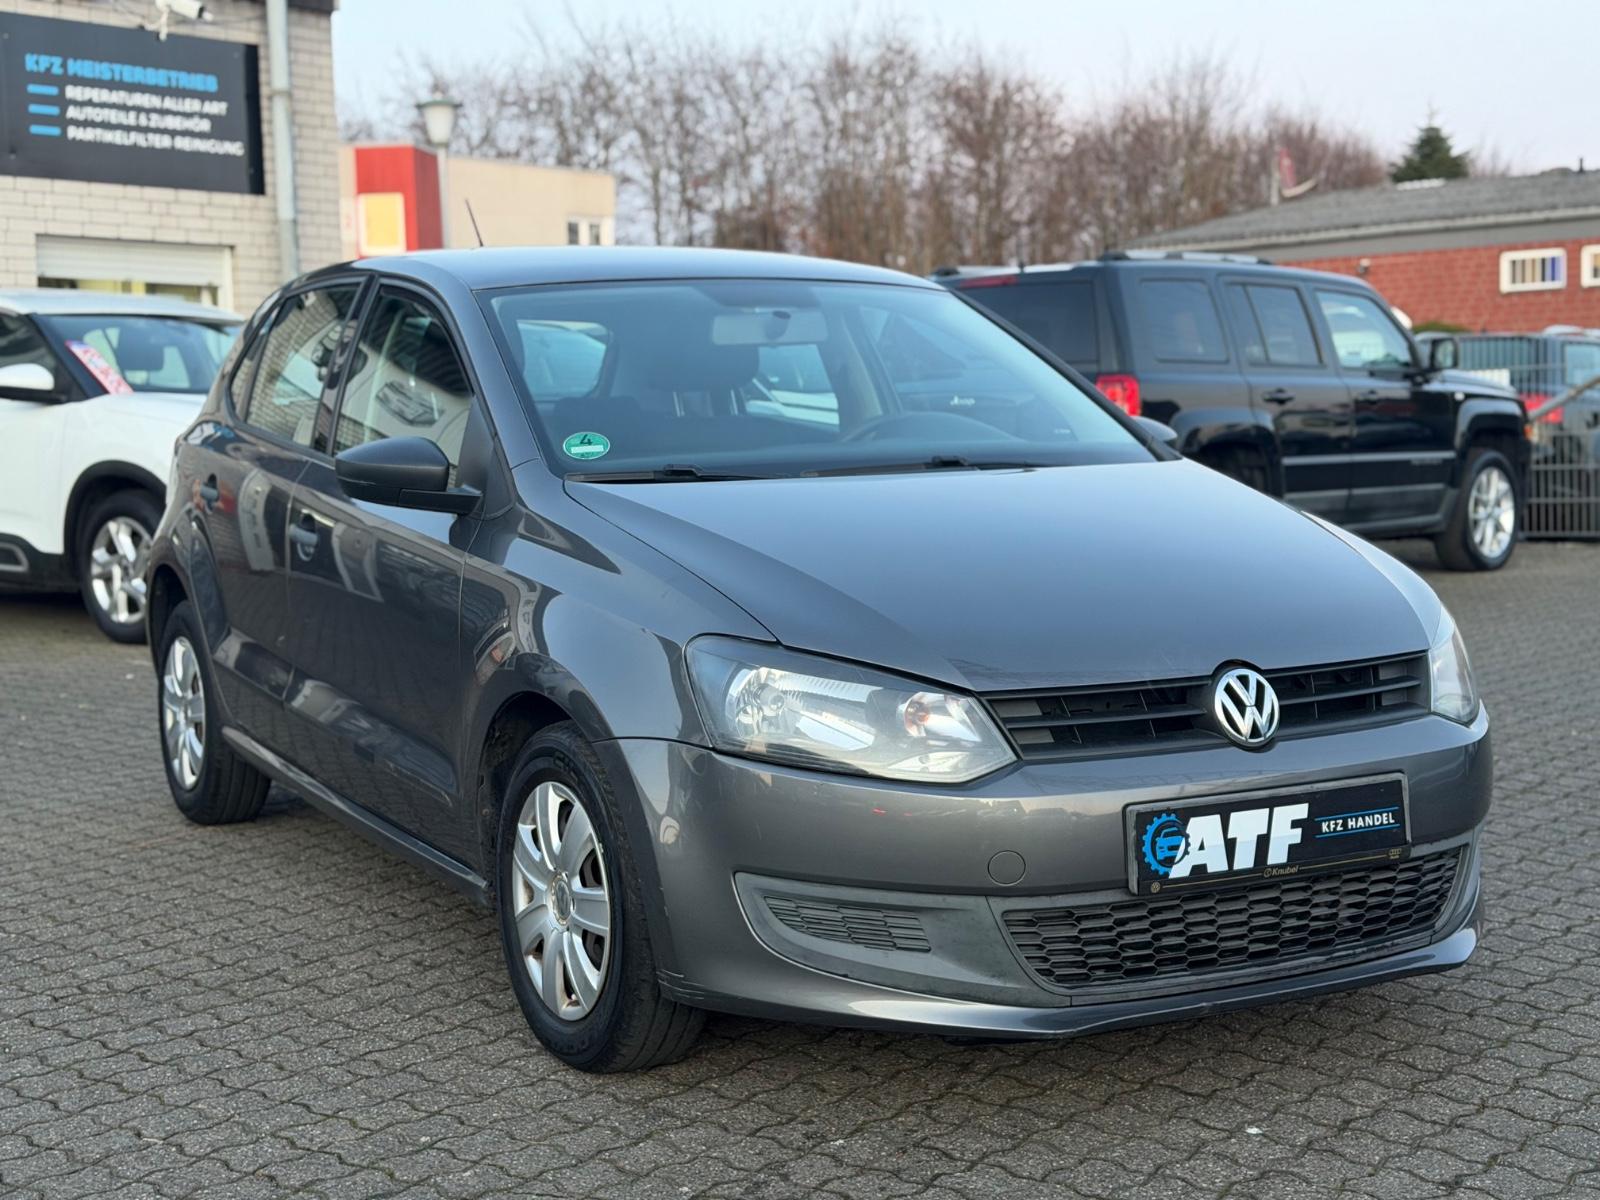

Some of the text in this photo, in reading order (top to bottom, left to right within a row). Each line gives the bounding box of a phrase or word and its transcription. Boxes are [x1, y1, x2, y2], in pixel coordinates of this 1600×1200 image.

[25, 53, 218, 93] KFZ MEISTERBETRIEB
[66, 105, 137, 127] AUTOTEILE
[580, 434, 593, 445] 4
[1321, 812, 1395, 833] KFZ HANDEL
[1168, 803, 1309, 879] ATF
